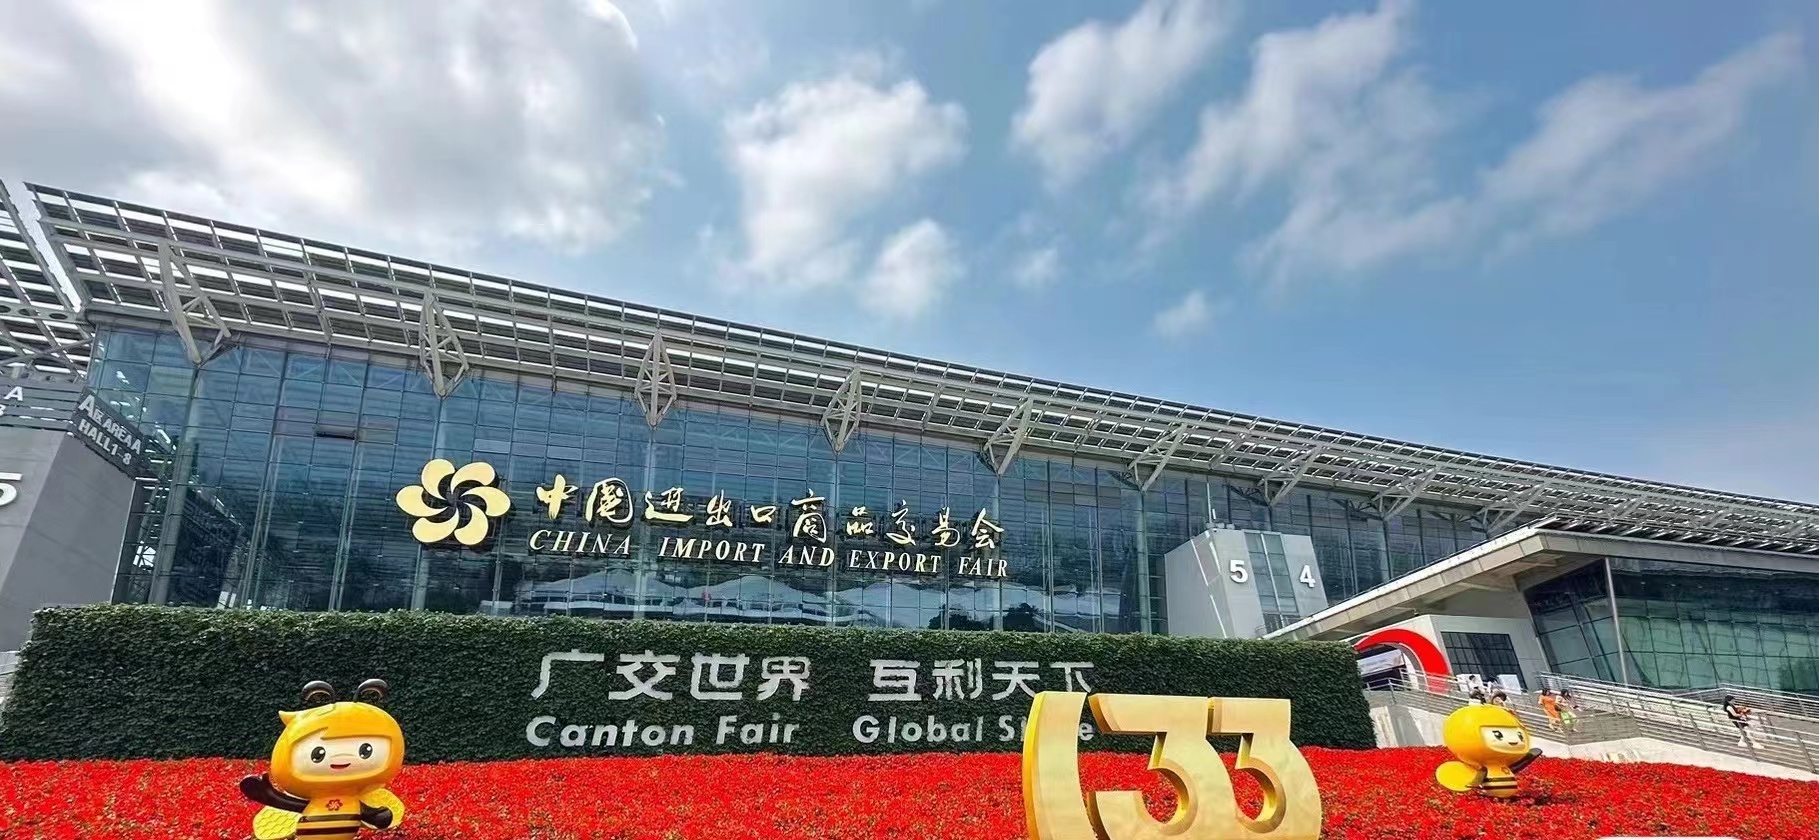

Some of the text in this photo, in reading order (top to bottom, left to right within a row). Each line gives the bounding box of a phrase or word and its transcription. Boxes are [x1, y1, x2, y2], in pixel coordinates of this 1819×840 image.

[4, 386, 23, 401] A
[529, 528, 1009, 577] CHINA IMPORT AND EXPORT FAIR
[1229, 559, 1249, 583] 5
[1299, 564, 1317, 588] 4
[530, 649, 1095, 702] 广交世界 互利天下
[525, 715, 695, 747] Canton
[715, 713, 801, 745] Fair
[851, 715, 984, 744] Global
